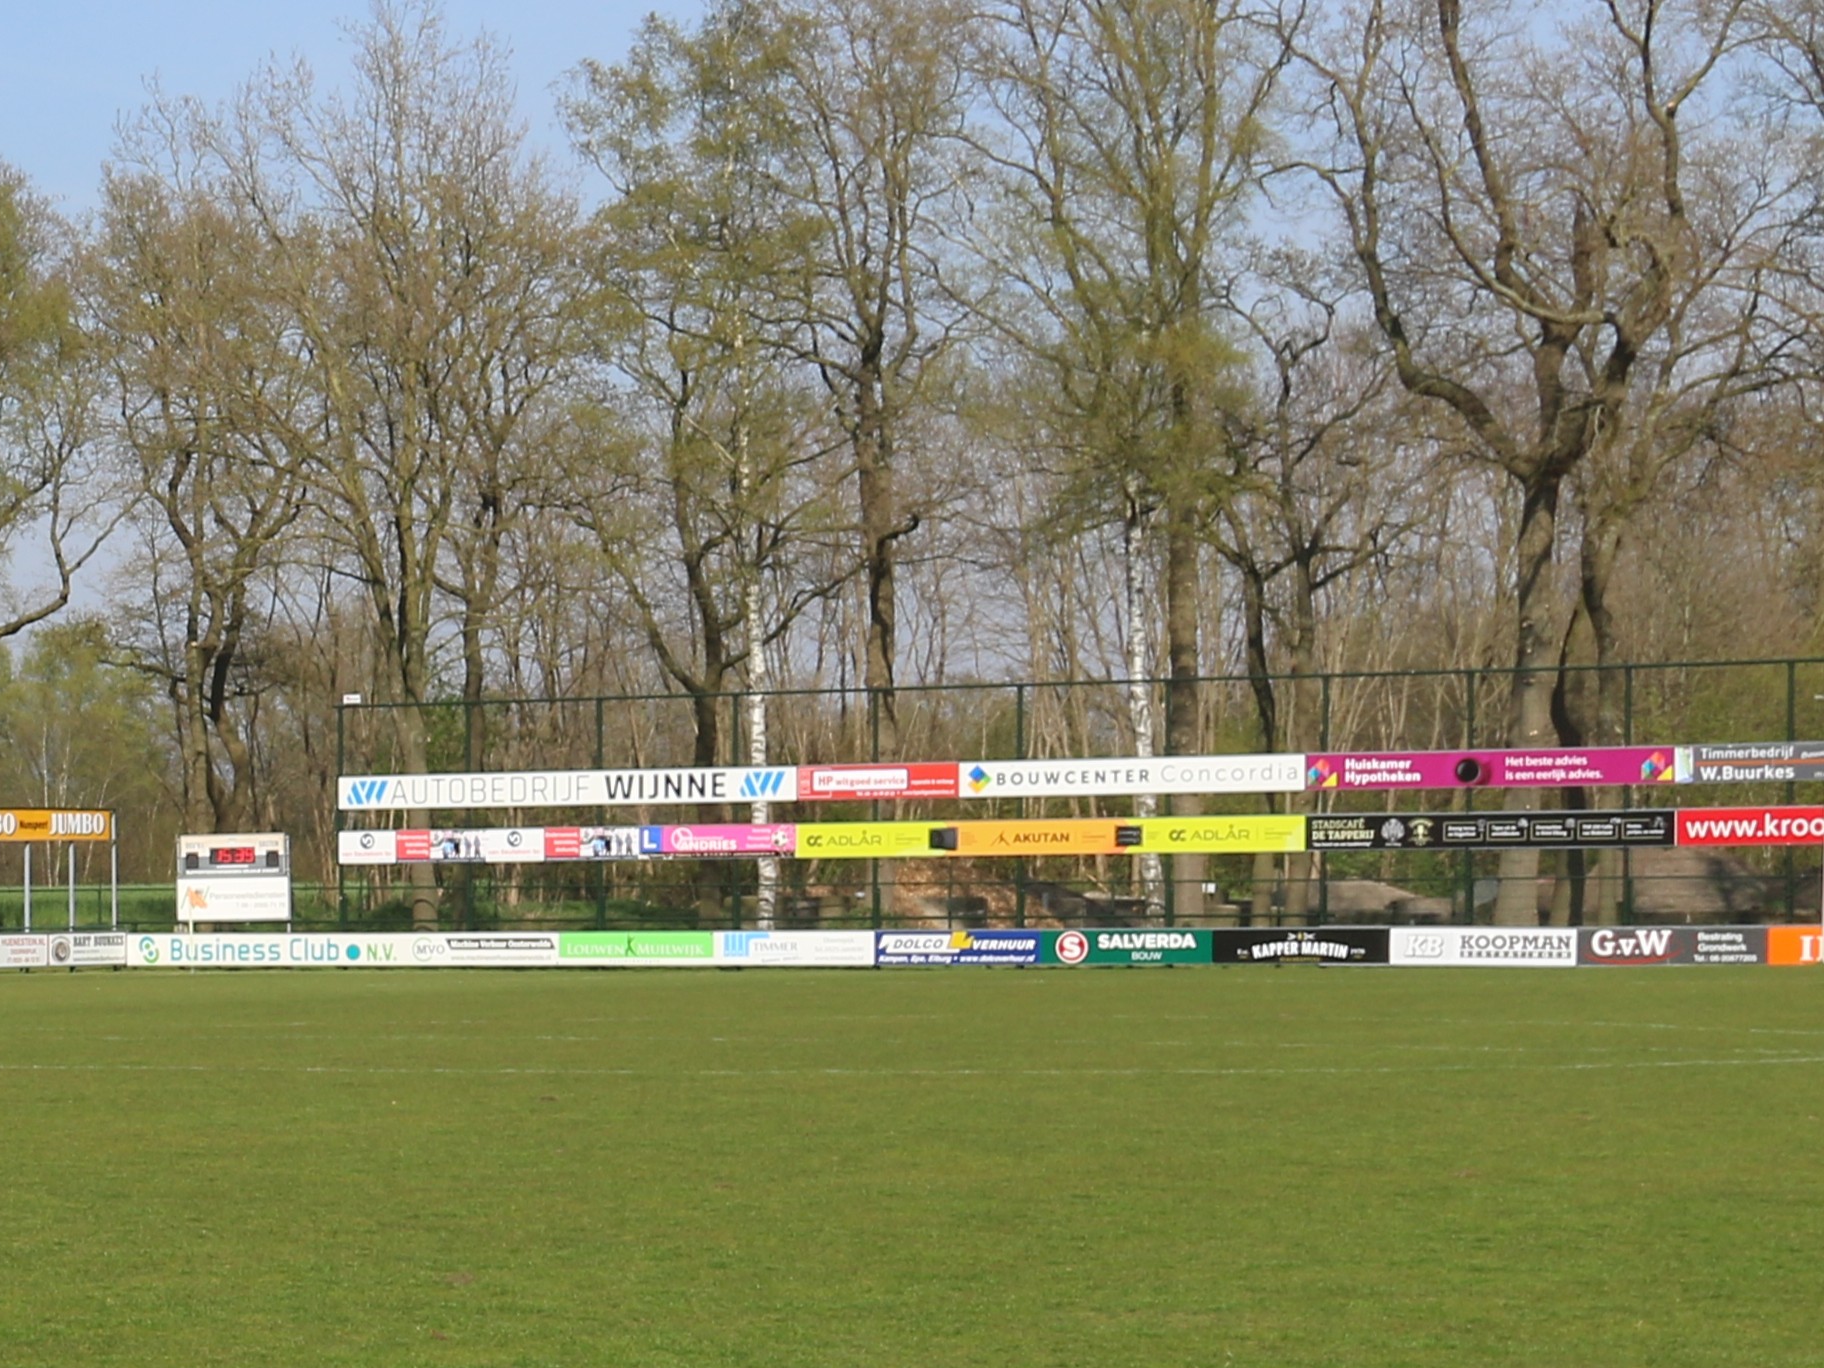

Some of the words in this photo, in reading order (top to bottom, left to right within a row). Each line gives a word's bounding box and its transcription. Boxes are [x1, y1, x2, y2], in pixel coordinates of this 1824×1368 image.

[1505, 756, 1524, 766] Het
[1525, 756, 1554, 766] beste
[1554, 755, 1588, 766] advies
[1700, 746, 1794, 761] Timmerbedrijf
[1344, 757, 1412, 770] Huiskamer
[996, 769, 1151, 787] BOUWCENTER
[1160, 764, 1298, 783] Concordia
[1344, 771, 1422, 786] Hypotheken
[1515, 771, 1535, 780] een
[1535, 769, 1567, 782] eerlijk
[1700, 764, 1795, 781] W.Buurkes
[390, 775, 590, 805] AUTOBEDRIJF
[604, 772, 726, 800] WIJNNE
[818, 775, 834, 787] HP
[835, 776, 871, 789] witgoed
[873, 775, 905, 786] service
[49, 811, 105, 836] JUMBO
[1685, 812, 1824, 838] www.kroo
[642, 829, 657, 850] L
[1012, 832, 1071, 844] AKUTAN
[1311, 830, 1326, 842] DE
[1327, 829, 1375, 842] TAPPERIJ
[680, 838, 737, 852] ANDRIES
[893, 938, 944, 950] DOLCO
[972, 938, 1036, 950] VERHUUR
[1097, 933, 1198, 950] SALVERDA
[1461, 935, 1572, 951] KOOPMAN
[1591, 929, 1672, 958] G.v.W
[1697, 932, 1743, 943] Bestrating
[170, 938, 281, 962] Business
[289, 938, 340, 962] Club
[366, 943, 397, 961] N.V.
[416, 944, 445, 956] MVO
[566, 941, 627, 956] LOUWEN
[637, 941, 704, 956] MUILWIJK
[1251, 940, 1300, 960] KAPPER
[1300, 940, 1350, 960] MARTIN
[1697, 943, 1747, 953] Grondwerk
[1130, 951, 1163, 961] BOUW
